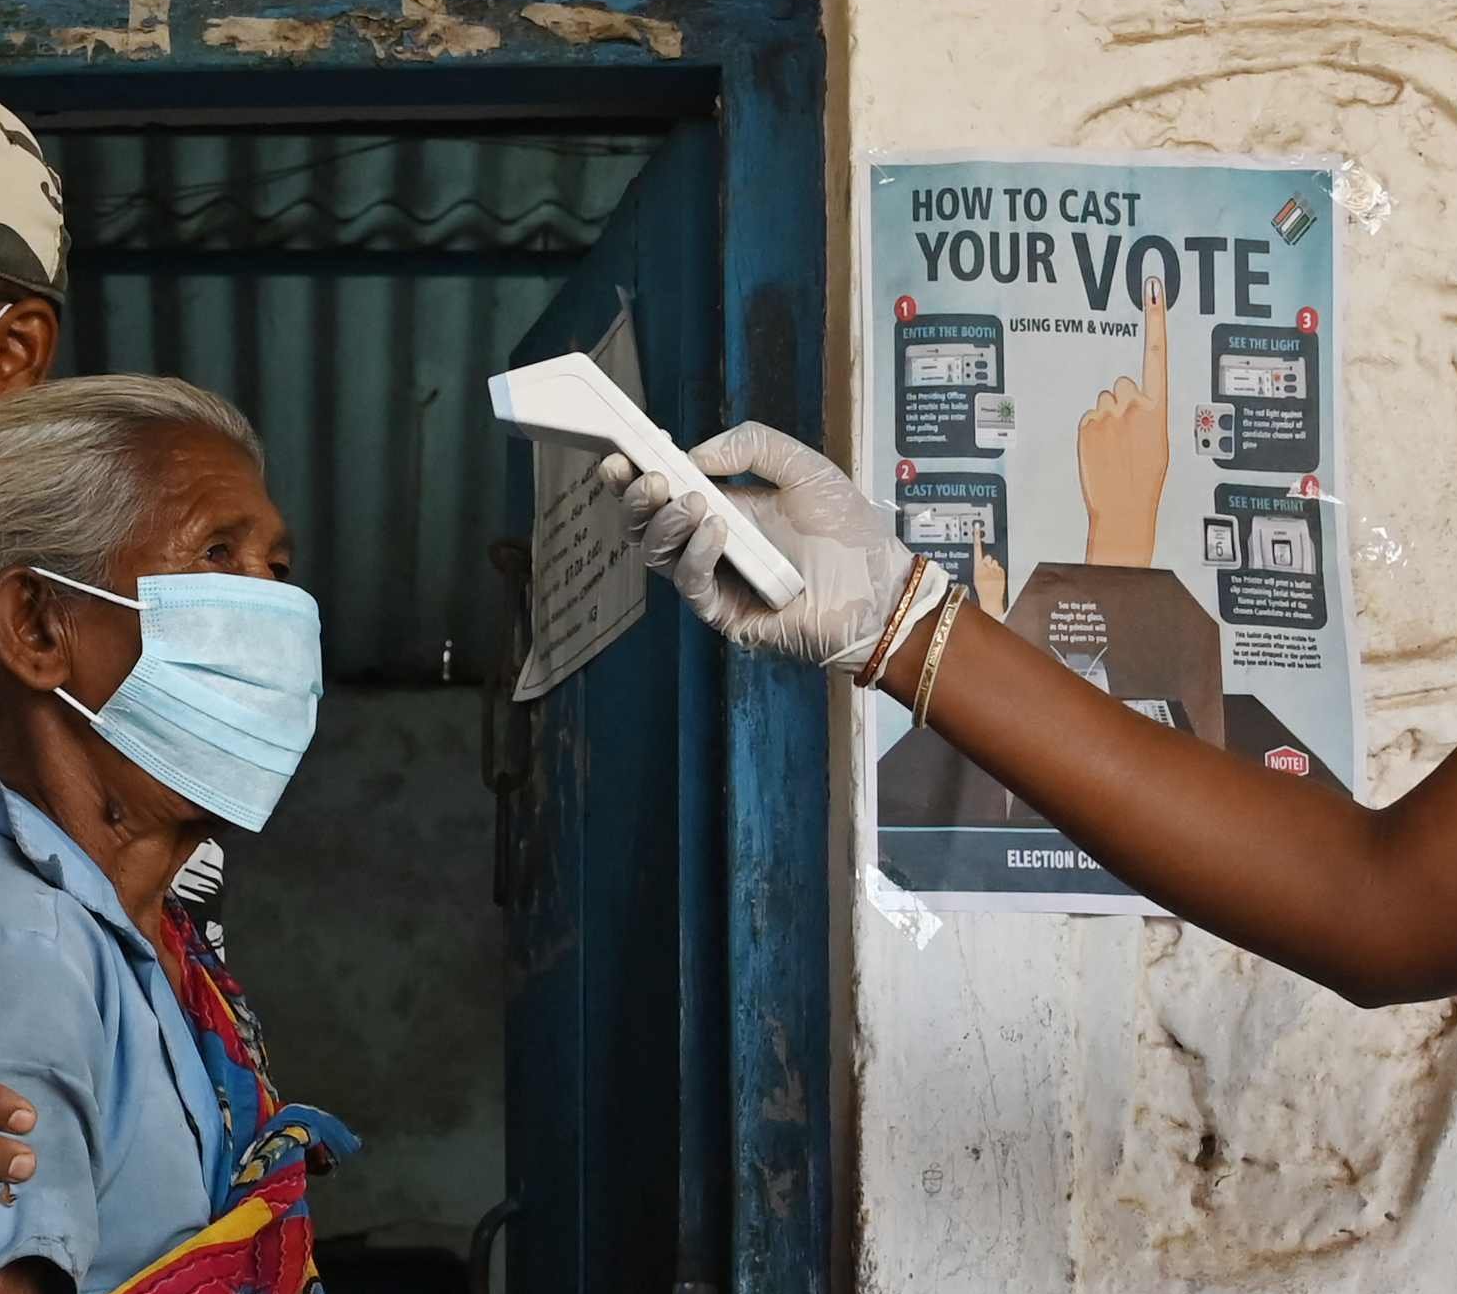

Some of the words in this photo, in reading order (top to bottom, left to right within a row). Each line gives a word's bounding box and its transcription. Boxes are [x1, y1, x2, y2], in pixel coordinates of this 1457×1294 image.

[912, 187, 993, 222] HOW
[1003, 188, 1048, 222] TO
[1059, 189, 1141, 227] CAST
[916, 230, 1057, 284] YOUR
[1071, 232, 1272, 319] VOTE
[901, 301, 908, 317] 1
[1009, 318, 1050, 334] USING
[1054, 319, 1084, 334] EVM
[1087, 320, 1096, 334] &
[1100, 321, 1140, 338] VVPAT
[1302, 313, 1311, 328] 3
[903, 327, 936, 339] ENTER
[939, 326, 958, 338] THE
[961, 326, 997, 338] BOOTH
[1229, 337, 1246, 348] SEE
[1249, 338, 1268, 350] THE
[1271, 339, 1300, 351] LIGHT
[901, 465, 909, 479] 2
[905, 484, 933, 497] CAST
[935, 484, 966, 497] YOUR
[968, 485, 998, 498] VOTE
[1229, 496, 1248, 509] SEE
[1250, 497, 1271, 511] THE
[1273, 498, 1304, 512] PRINT
[1270, 755, 1304, 771] NOTE!
[1007, 849, 1074, 869] ELECTION
